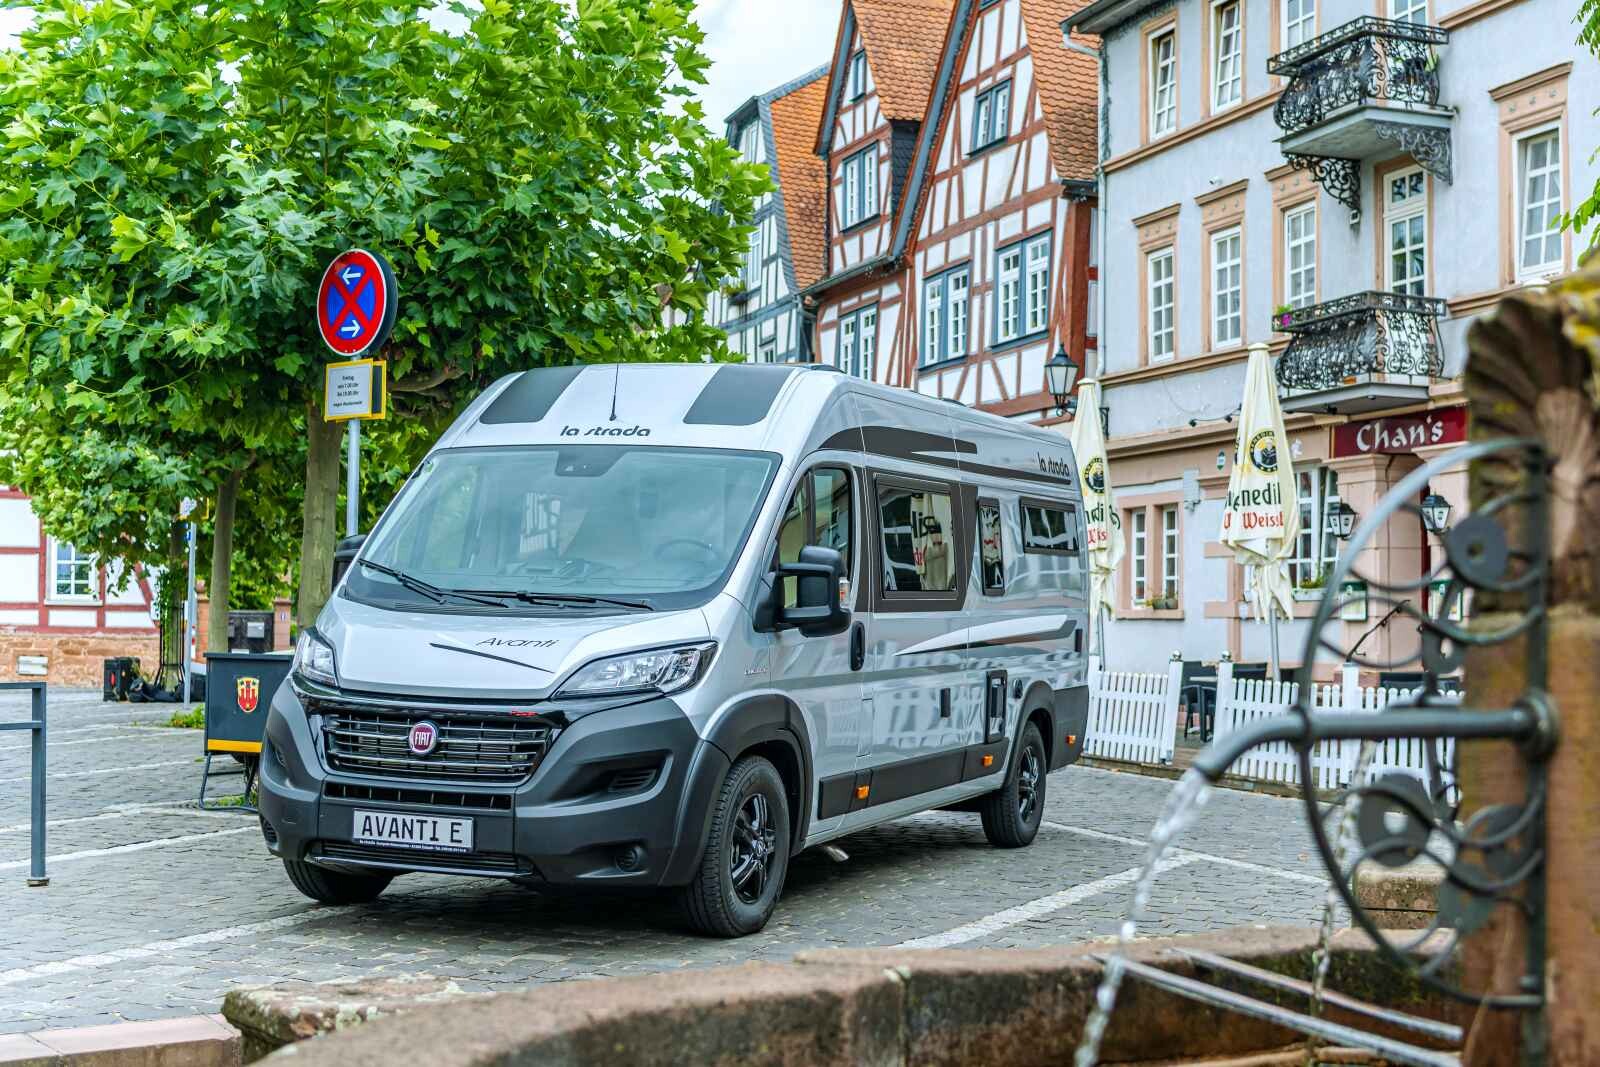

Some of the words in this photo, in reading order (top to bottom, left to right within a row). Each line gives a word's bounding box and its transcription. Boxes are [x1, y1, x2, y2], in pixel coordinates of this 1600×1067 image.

[560, 425, 580, 437] la
[584, 425, 651, 437] strada
[1356, 415, 1444, 452] Chan's
[475, 637, 560, 648] Avanti
[414, 731, 432, 747] FIAT
[361, 815, 439, 842] AVANTI
[450, 821, 463, 844] E
